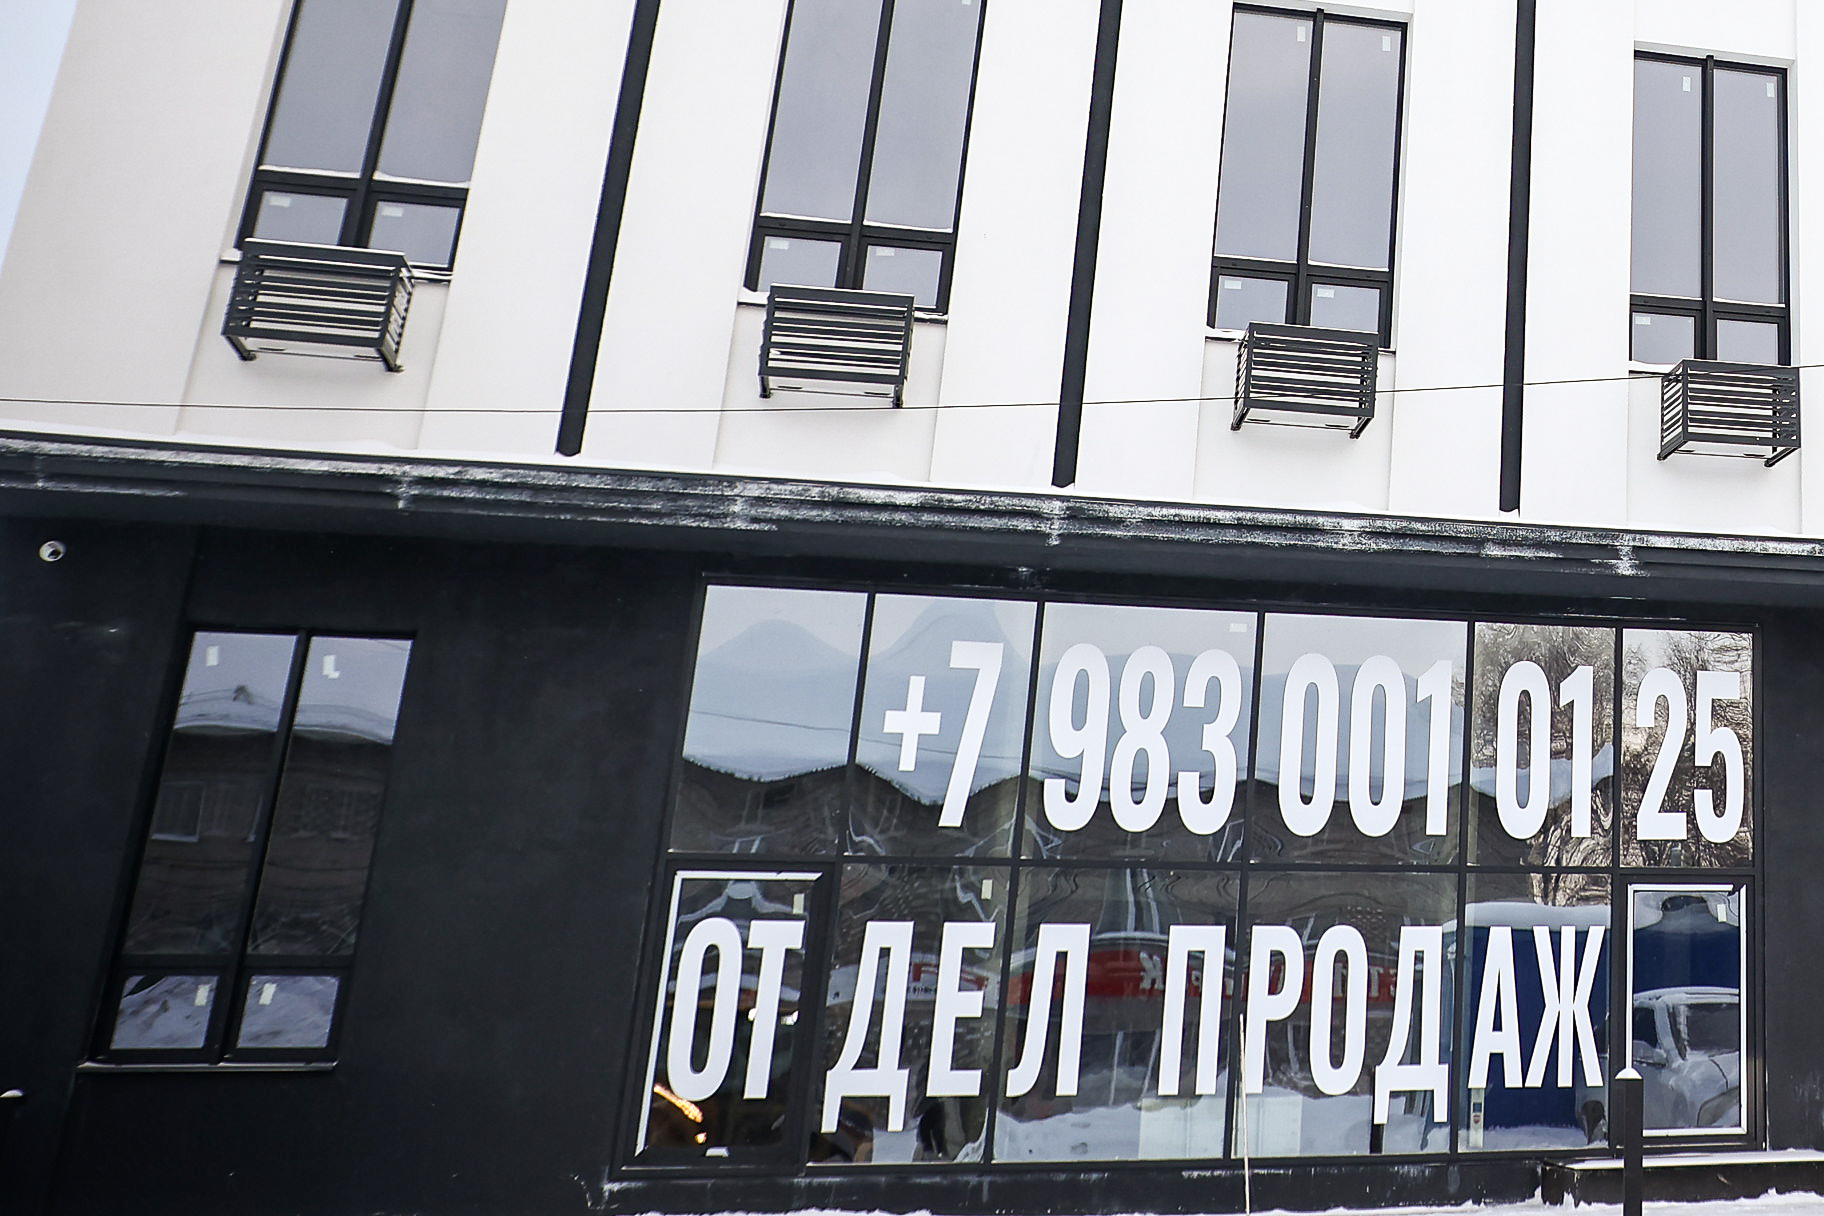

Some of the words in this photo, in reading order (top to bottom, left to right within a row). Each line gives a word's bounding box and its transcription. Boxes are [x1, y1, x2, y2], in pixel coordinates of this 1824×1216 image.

[883, 640, 1004, 827] +7
[1043, 643, 1242, 835] 983
[1278, 652, 1452, 837] 001
[1495, 660, 1594, 840] 01
[1636, 667, 1743, 844] 25
[1158, 924, 1606, 1125] ПРОДАЖ
